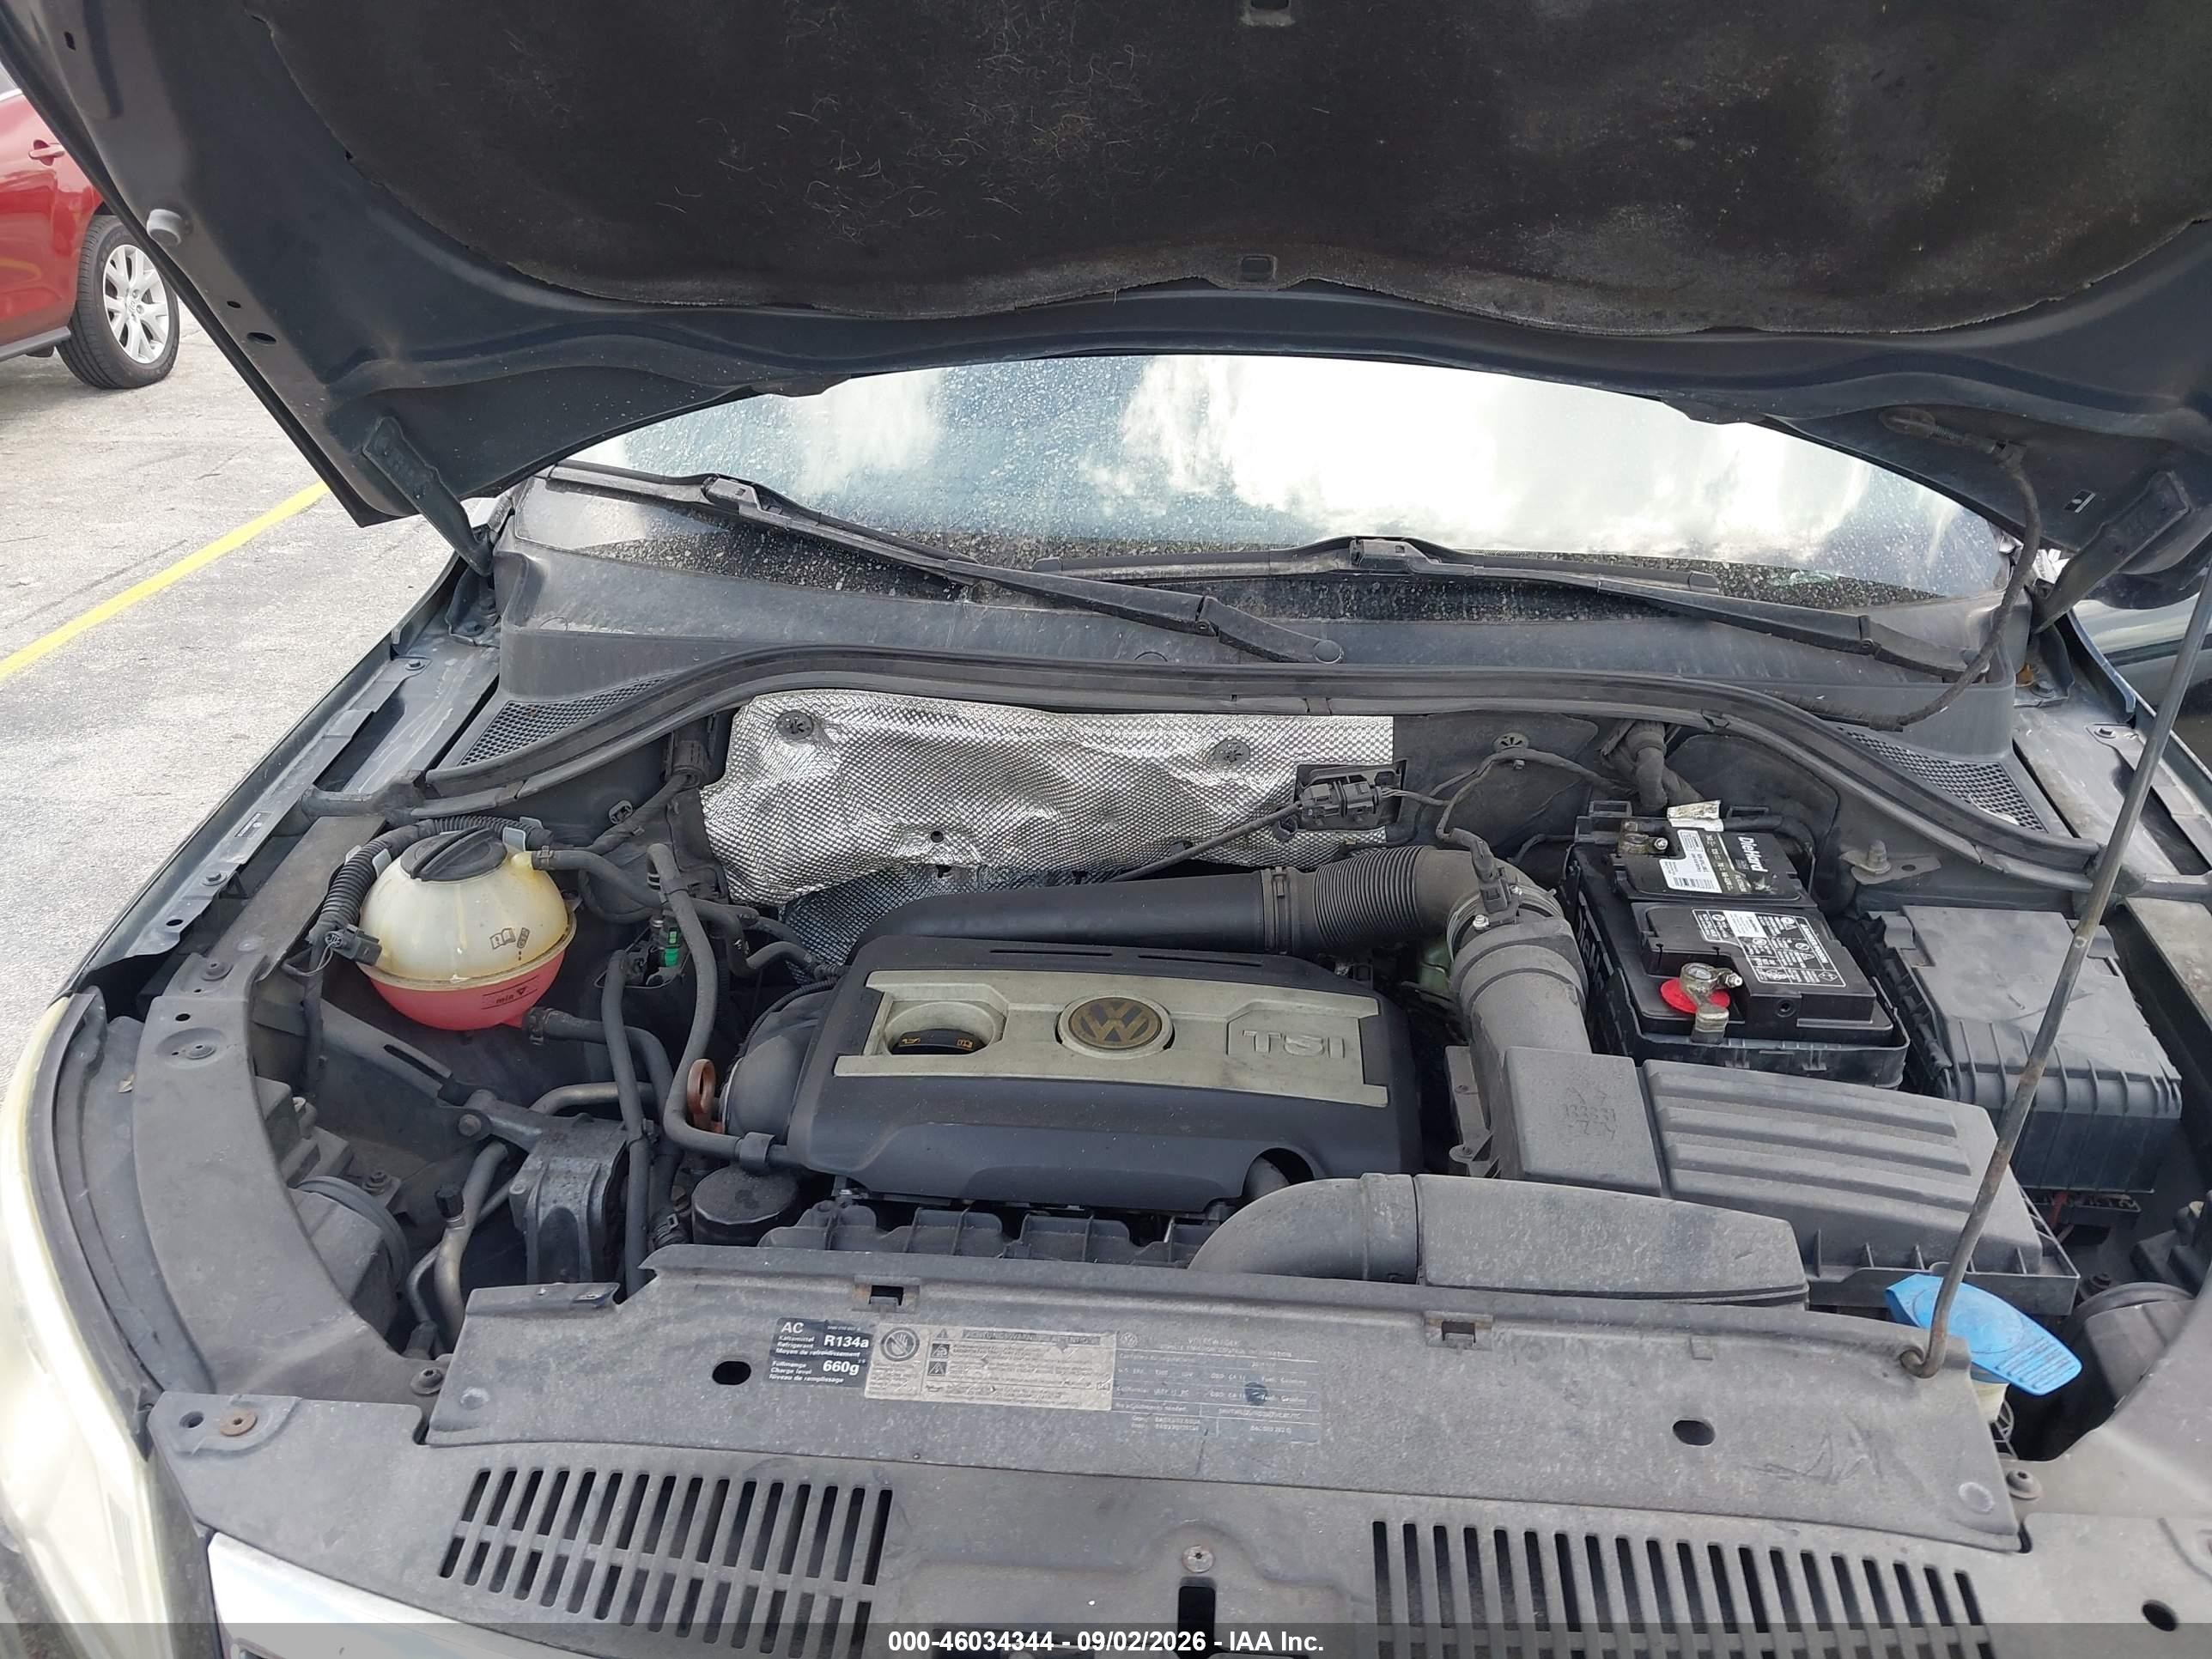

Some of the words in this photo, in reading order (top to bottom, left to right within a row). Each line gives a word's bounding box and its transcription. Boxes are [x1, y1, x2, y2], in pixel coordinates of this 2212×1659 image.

[1738, 836, 1769, 872] DieHard
[1803, 927, 1818, 945] DANGER
[1814, 945, 1829, 963] POISON
[1243, 1030, 1346, 1059] TSI
[781, 1322, 805, 1334] AC
[823, 1334, 869, 1348] R134a
[823, 1360, 860, 1376] 660g
